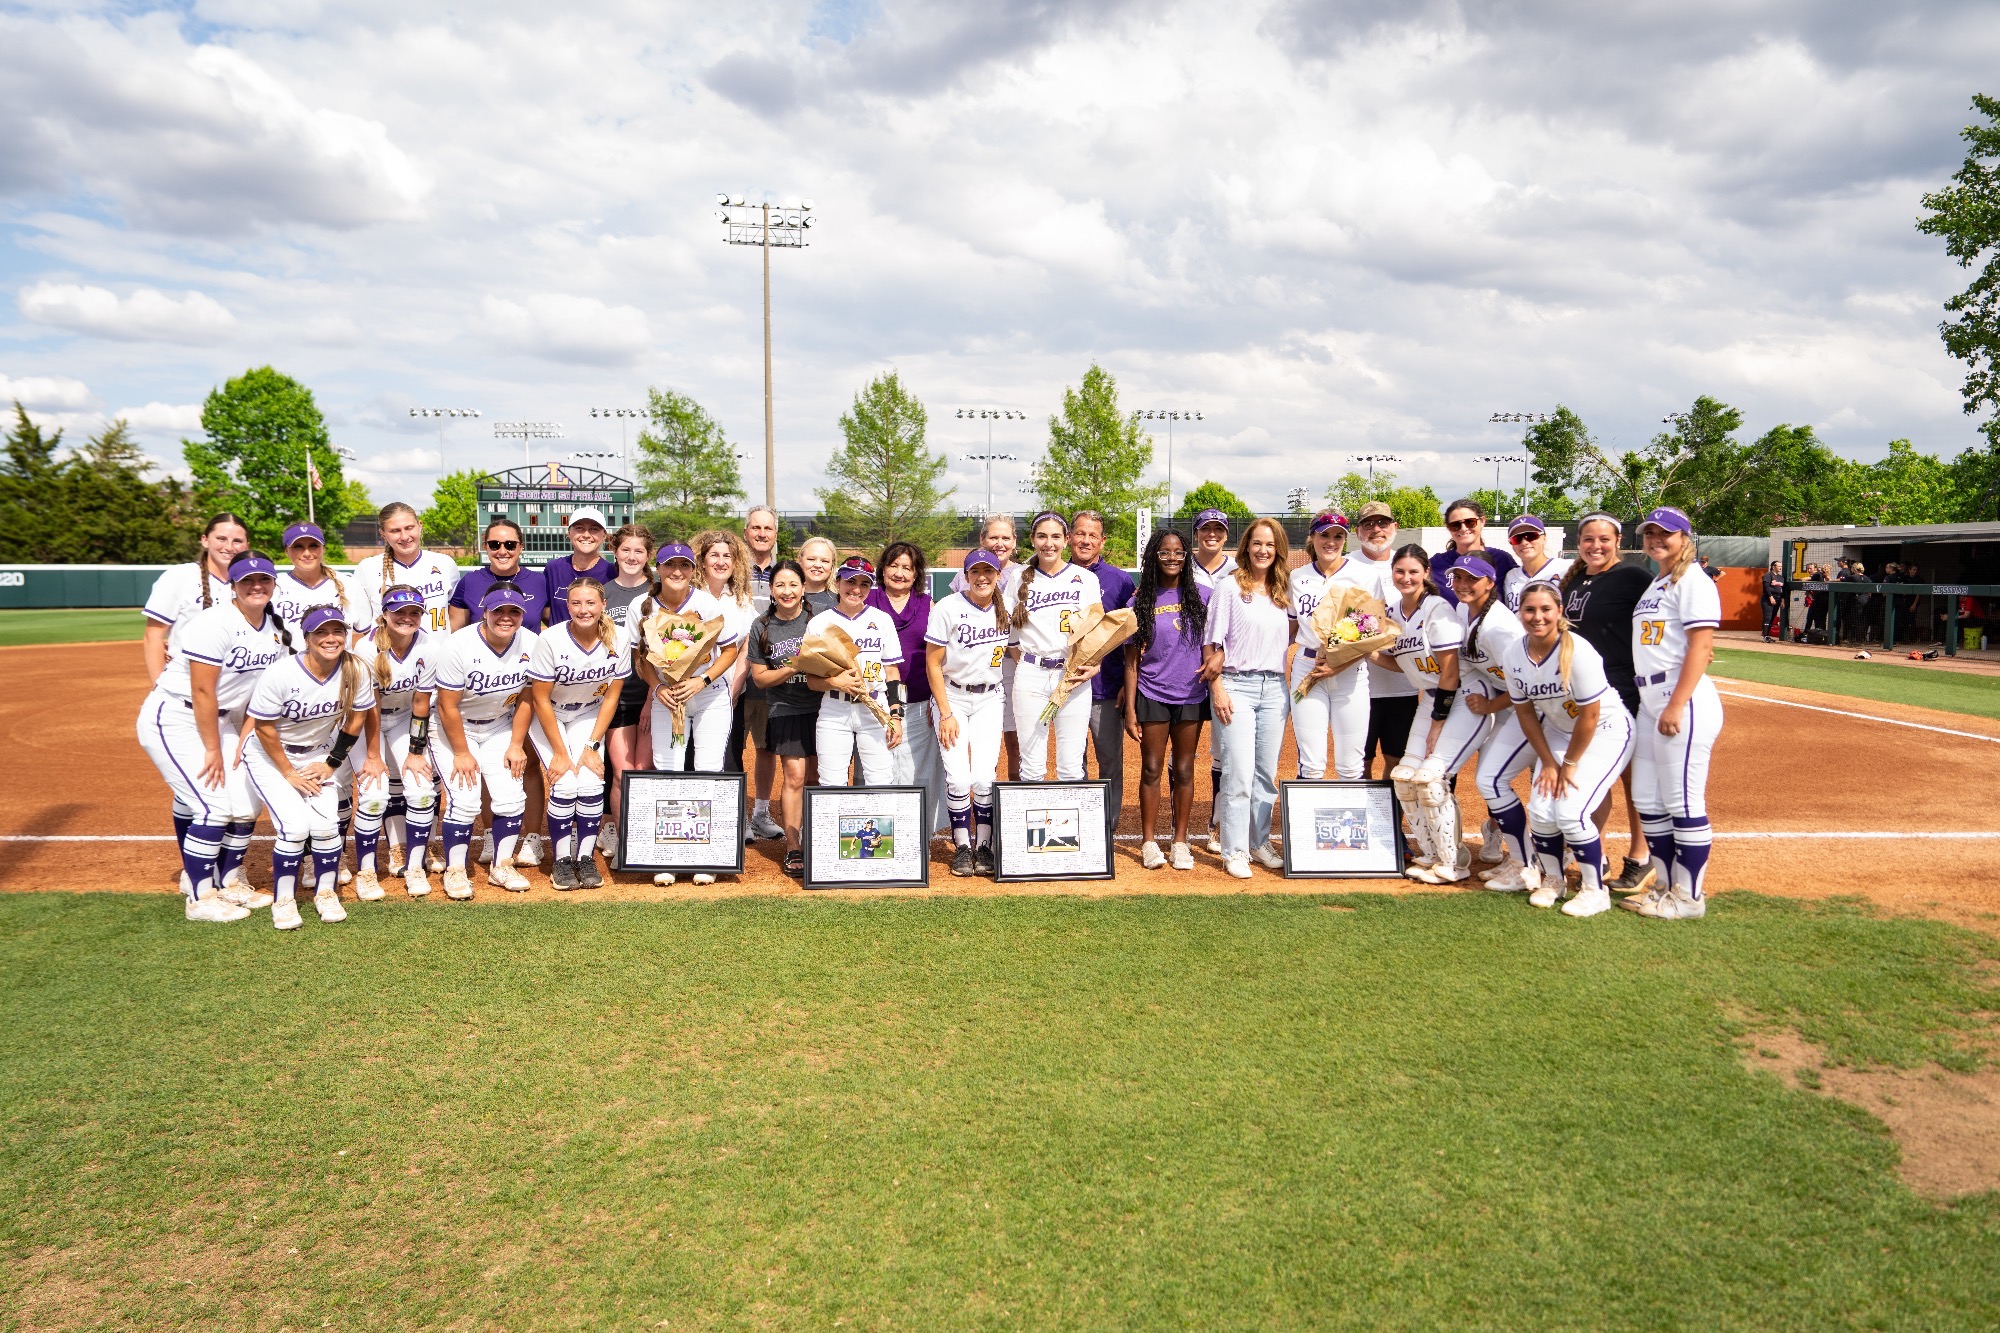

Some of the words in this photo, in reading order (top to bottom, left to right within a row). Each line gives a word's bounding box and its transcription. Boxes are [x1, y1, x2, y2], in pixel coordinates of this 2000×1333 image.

[547, 462, 569, 487] L
[500, 490, 557, 500] LIPSCOMB
[558, 491, 613, 501] SOFTBALL
[0, 572, 25, 587] 20
[1025, 589, 1081, 608] Bisons
[1154, 603, 1182, 614] IPSC
[429, 607, 446, 631] 14
[855, 637, 882, 648] ons
[1641, 621, 1665, 645] 27
[225, 646, 278, 669] Bison
[990, 645, 1007, 667] 2
[1414, 655, 1441, 674] 44
[555, 662, 617, 684] Bisons
[282, 699, 344, 720] Bison
[656, 822, 711, 835] LIPC
